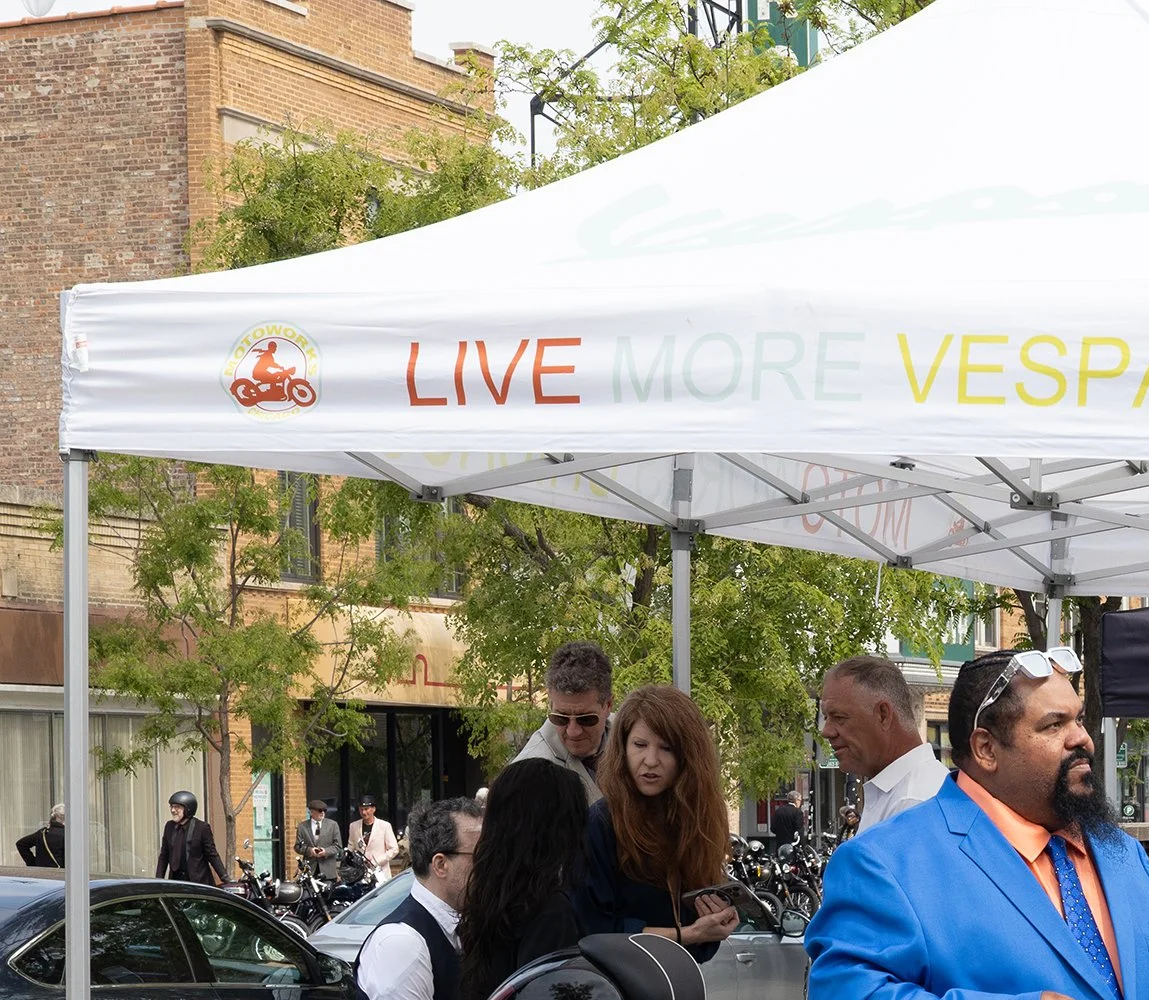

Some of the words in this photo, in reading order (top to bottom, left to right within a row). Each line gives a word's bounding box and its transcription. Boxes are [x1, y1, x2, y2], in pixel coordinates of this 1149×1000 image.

[224, 325, 318, 377] MOTOWORKS
[406, 337, 582, 406] LIVE
[612, 331, 866, 405] MORE
